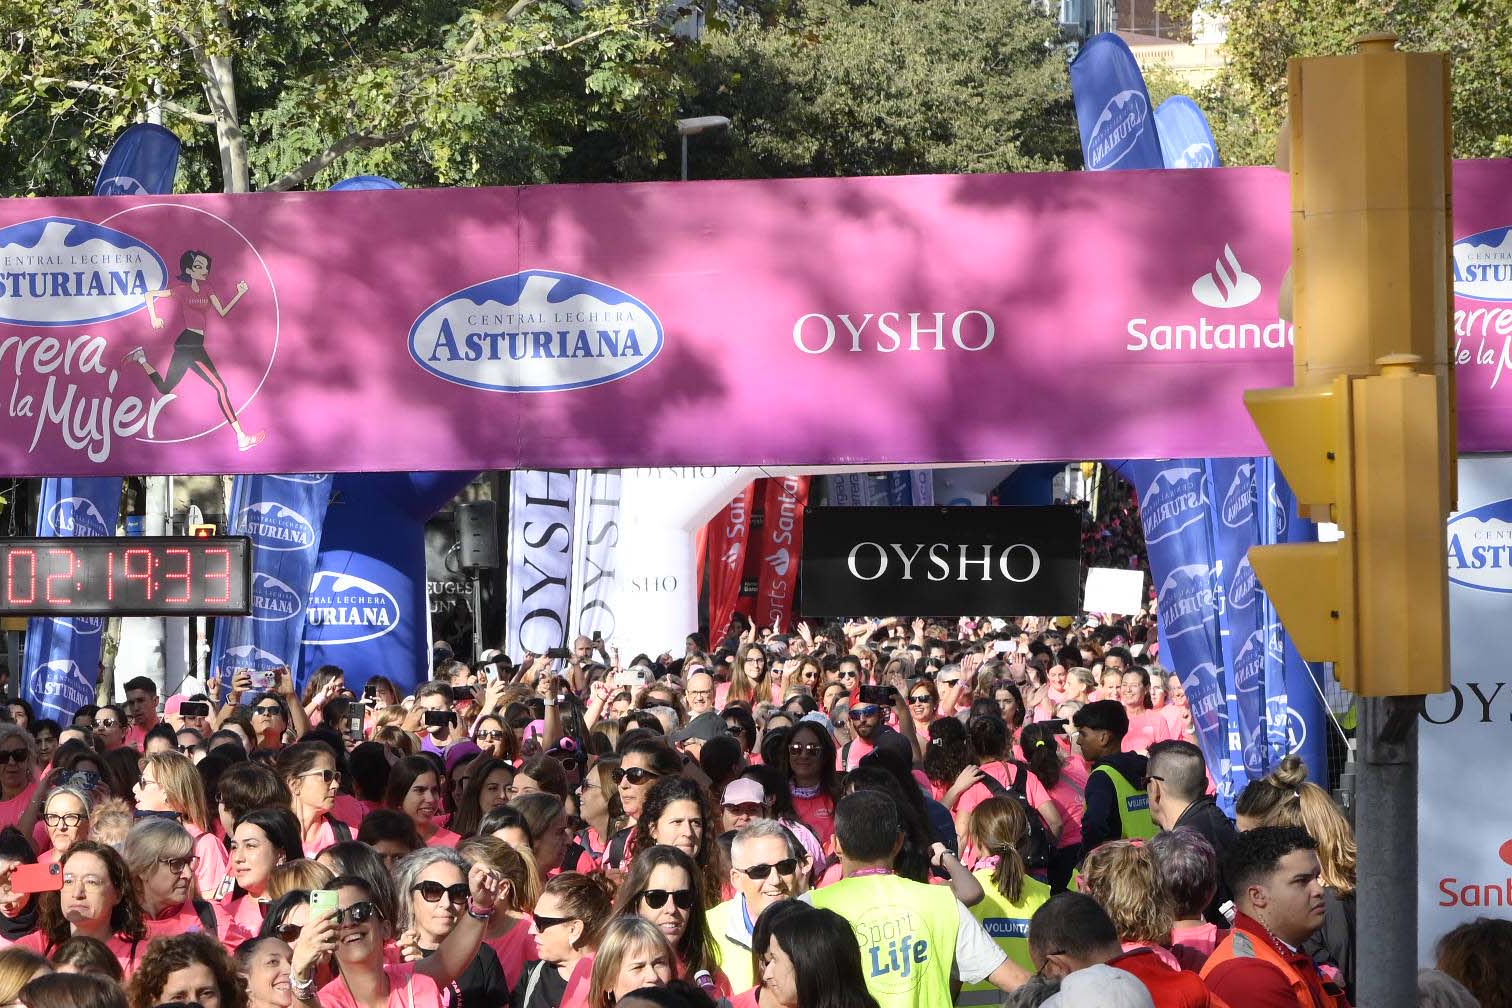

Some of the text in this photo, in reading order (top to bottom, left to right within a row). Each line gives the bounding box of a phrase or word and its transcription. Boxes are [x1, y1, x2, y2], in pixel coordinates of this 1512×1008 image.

[70, 253, 143, 265] LECHERA
[468, 310, 635, 327] CENTRAL LECHERA
[793, 309, 996, 354] OYSHO
[1126, 317, 1296, 352] Santand
[429, 317, 643, 363] ASTURIANA
[9, 377, 33, 417] la
[30, 368, 178, 463] Mujer
[239, 520, 308, 545] ASTURIANA
[1448, 533, 1512, 569] AST
[8, 549, 231, 604] 02:19:33
[848, 541, 1041, 584] OYSHO
[337, 597, 386, 605] LECHERA
[1419, 682, 1512, 724] OY
[854, 911, 919, 948] Sport
[869, 934, 928, 978] Life
